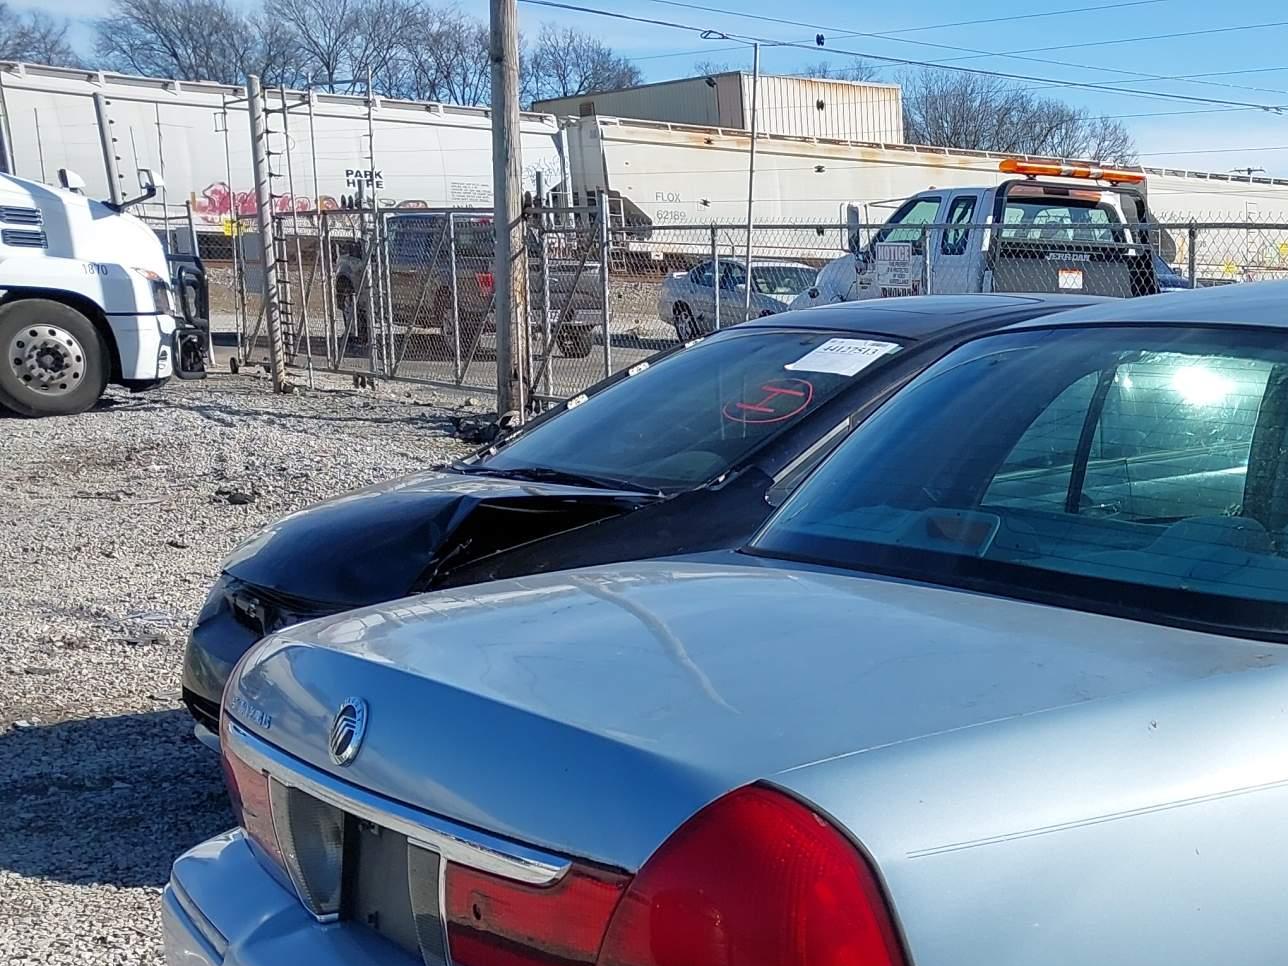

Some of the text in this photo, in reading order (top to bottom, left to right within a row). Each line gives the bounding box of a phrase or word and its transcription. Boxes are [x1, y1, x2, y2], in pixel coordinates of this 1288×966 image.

[345, 169, 383, 179] PARK
[346, 179, 384, 189] HRE
[655, 191, 681, 203] FLOX
[877, 245, 910, 261] NOTICE
